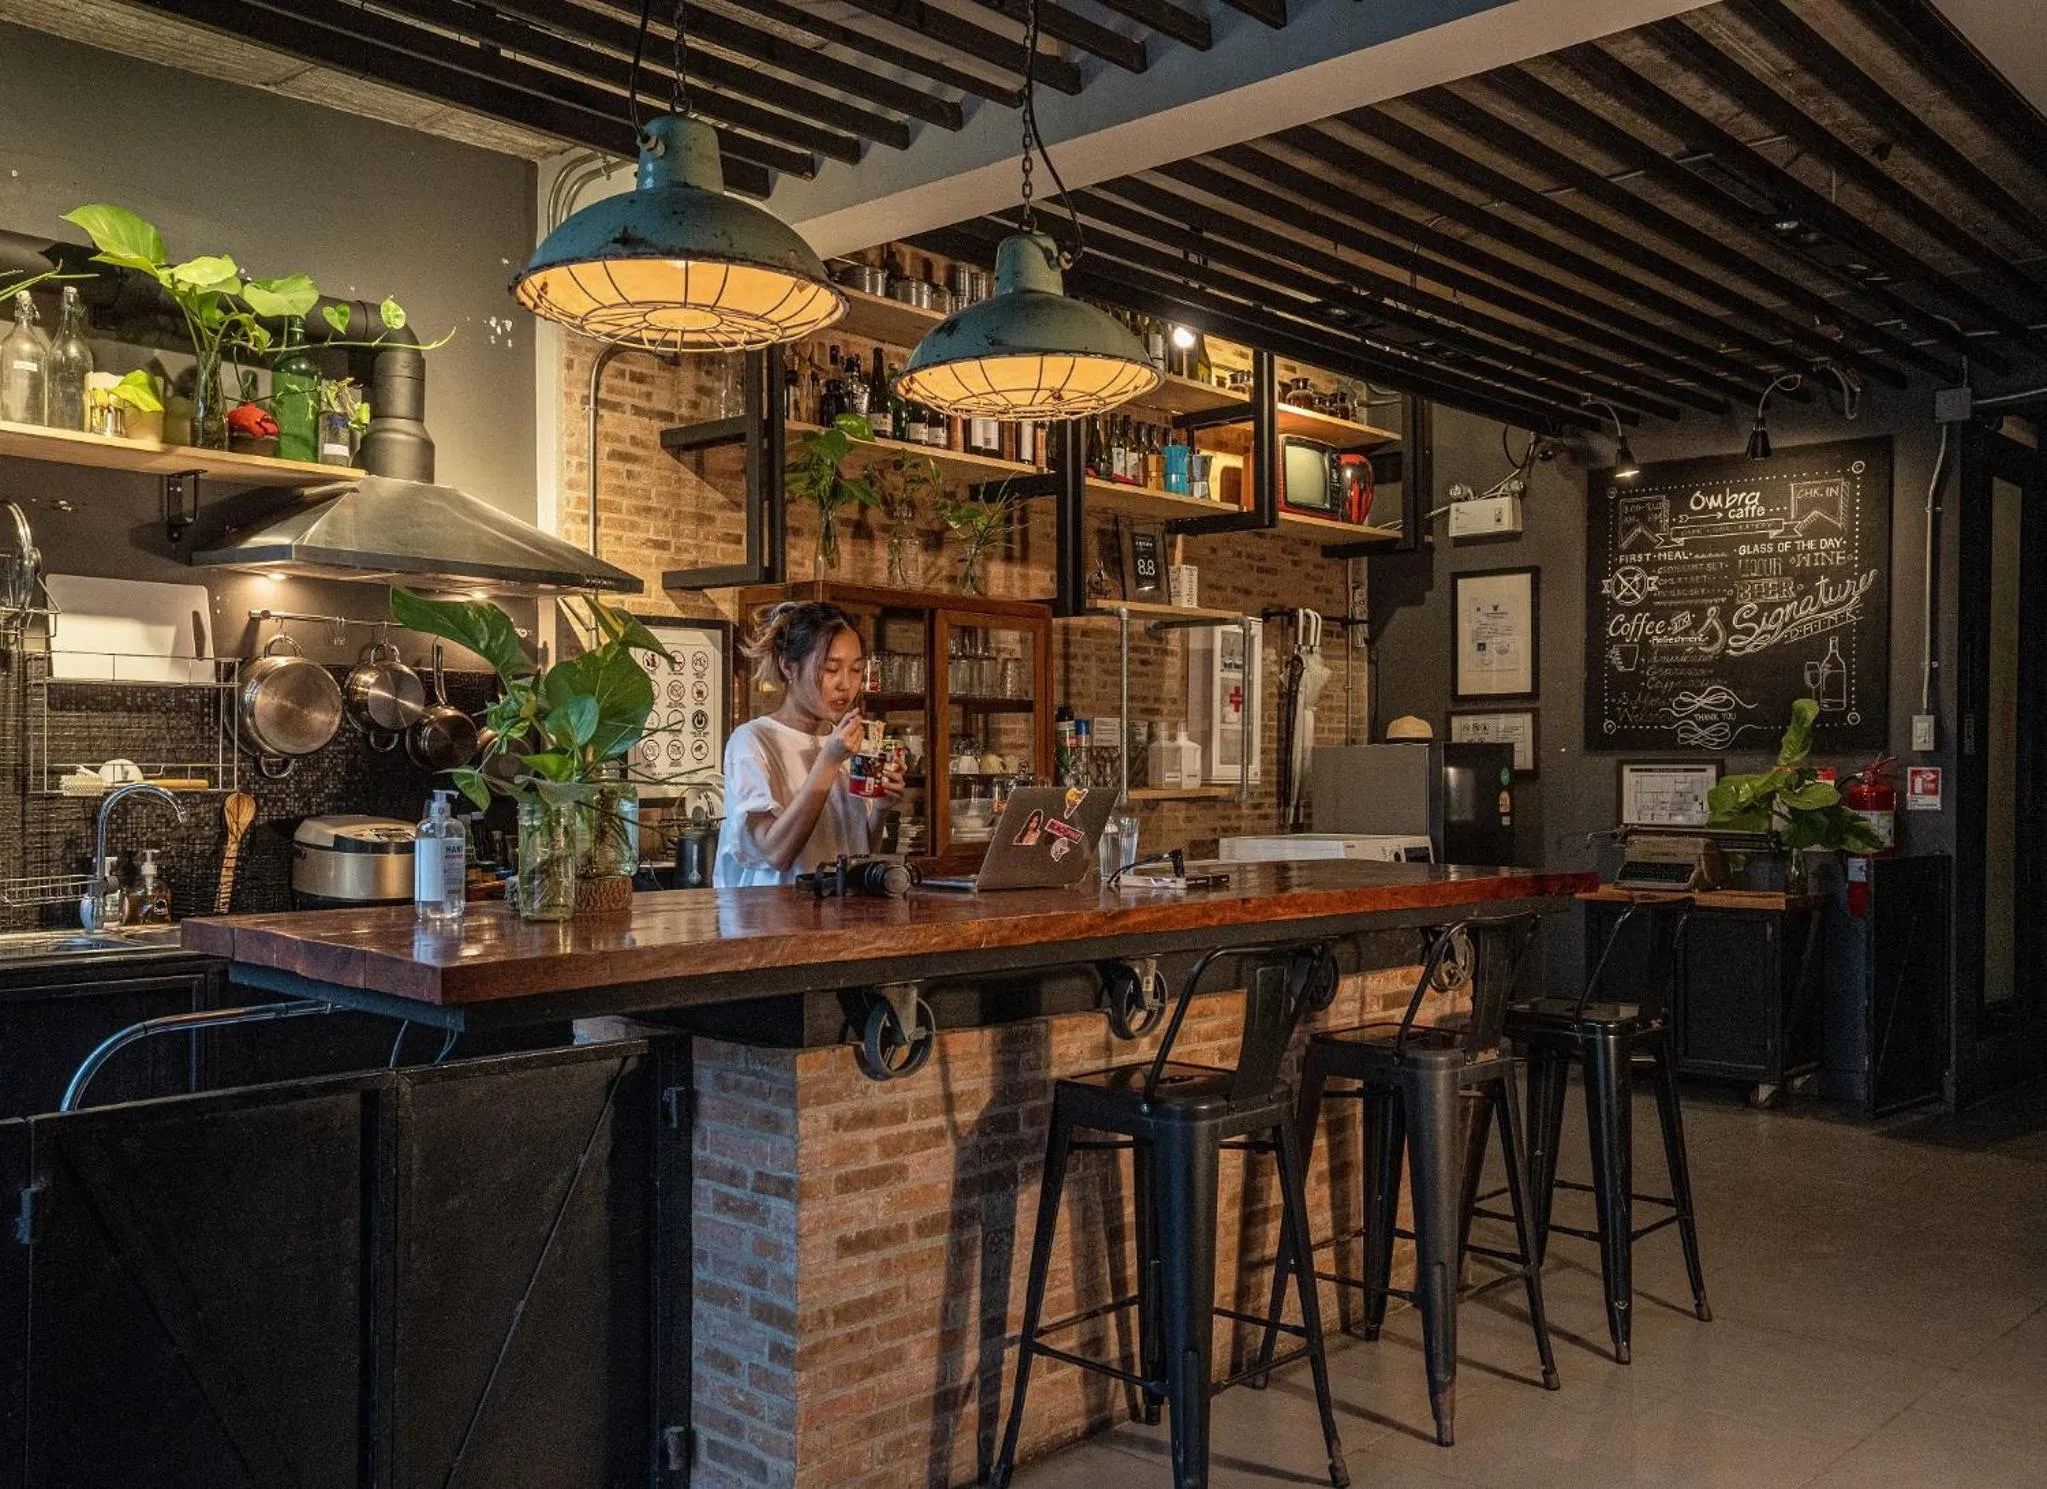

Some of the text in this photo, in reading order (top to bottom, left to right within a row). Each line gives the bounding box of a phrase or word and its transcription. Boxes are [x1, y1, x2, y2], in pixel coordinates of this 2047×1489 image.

[1690, 487, 1761, 511] Ombra
[1738, 537, 1843, 556] GLASS OF THE DAY
[1137, 558, 1156, 576] 8.8
[1620, 551, 1689, 564] FIRST MEAL
[1734, 579, 1797, 600] BEER
[1608, 613, 1666, 642] Coffee
[1721, 712, 1737, 720] YOU
